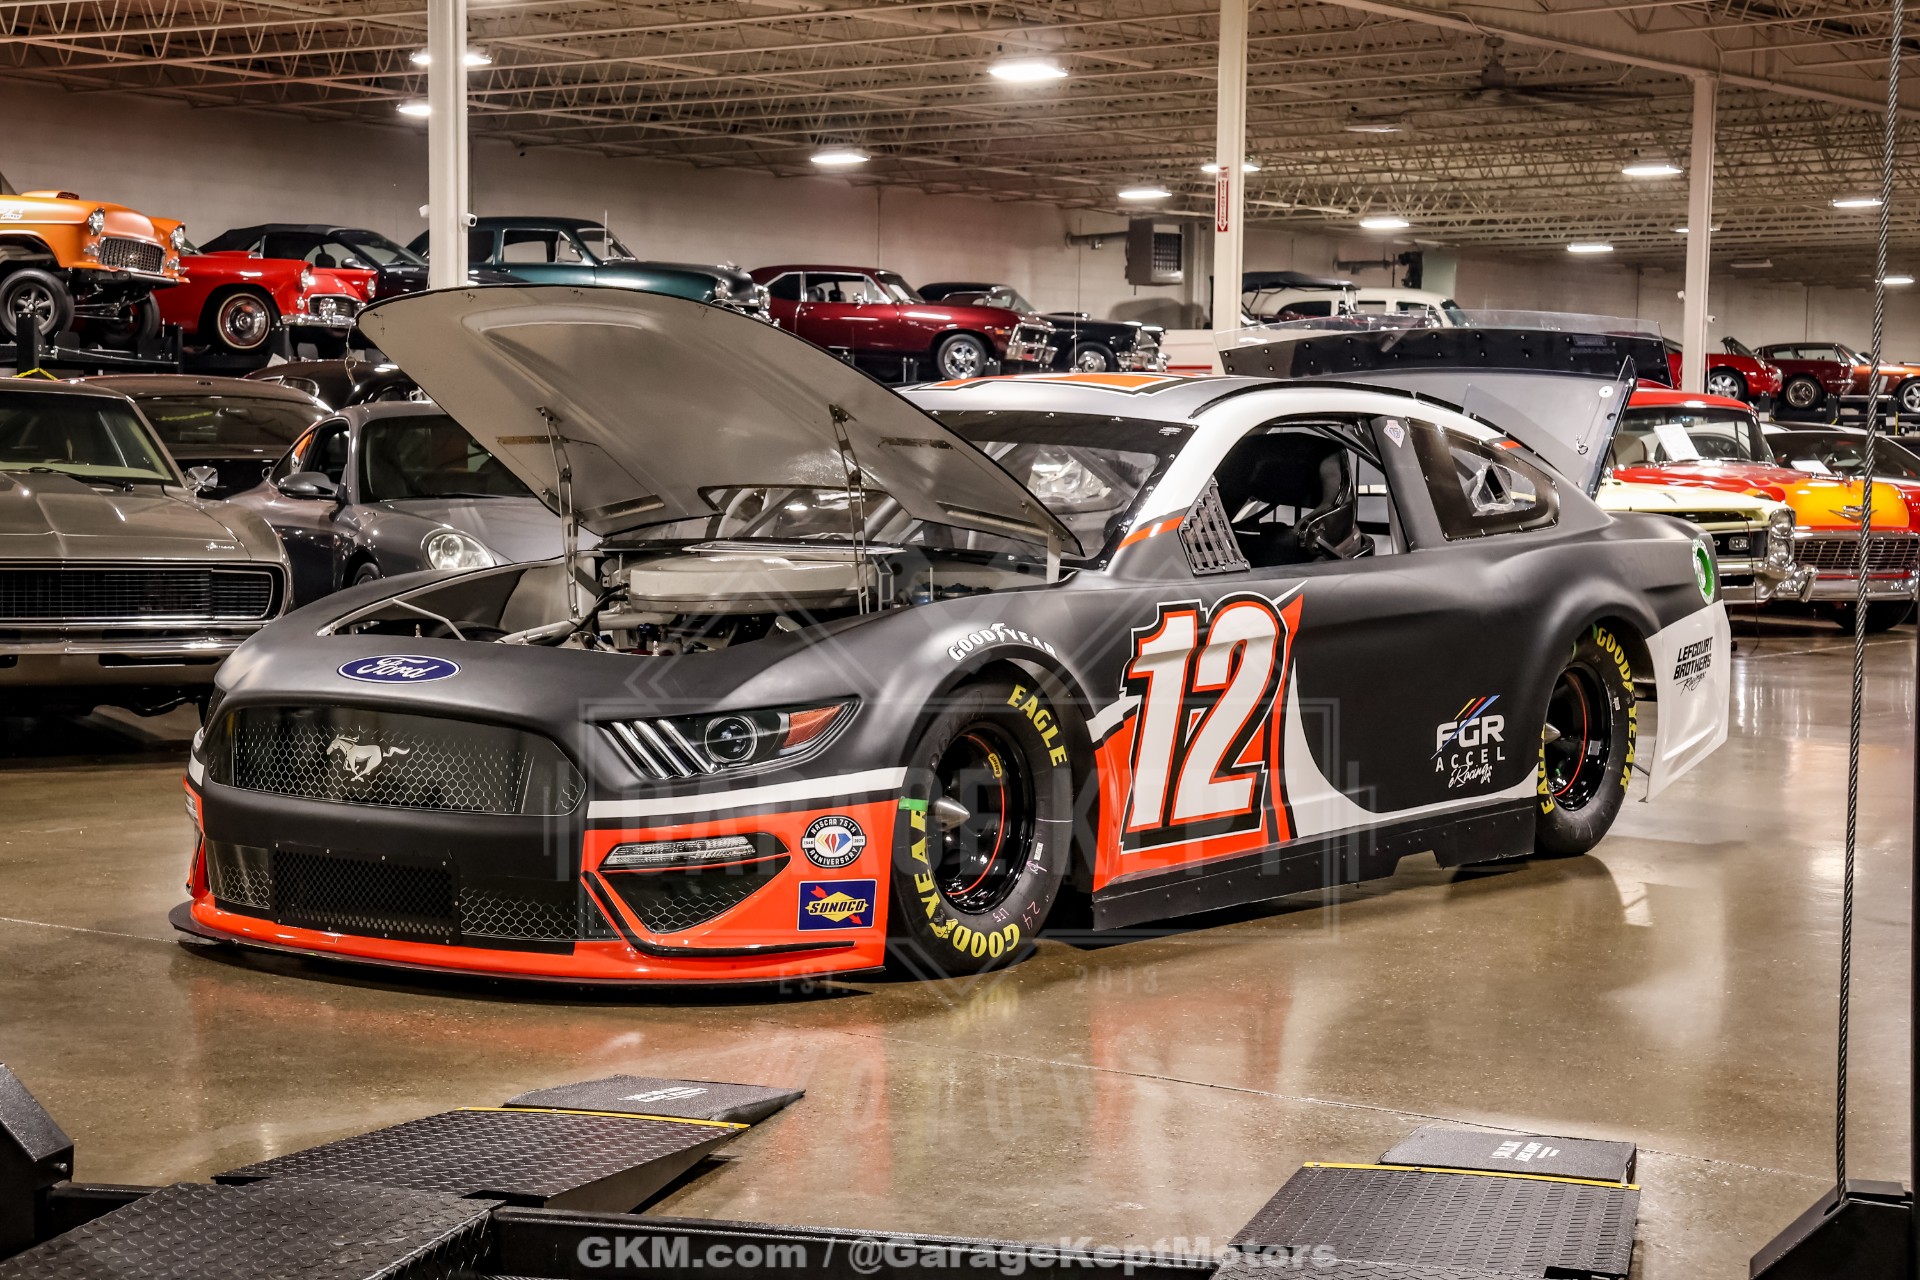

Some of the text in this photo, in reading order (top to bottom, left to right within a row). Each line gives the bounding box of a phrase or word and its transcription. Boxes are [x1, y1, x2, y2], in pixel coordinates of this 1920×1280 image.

[1677, 635, 1713, 663] LEFCOURT
[356, 656, 440, 679] Ford
[1673, 653, 1712, 680] BROTHERS
[1006, 683, 1069, 768] EAGLE
[1121, 591, 1288, 854] 12
[1434, 714, 1506, 753] FGR
[1435, 746, 1506, 773] ACCEL
[810, 818, 858, 835] NASCAR 75TH
[809, 846, 859, 866] ANNIVERSARY
[909, 806, 1021, 959] GOODYEAR
[809, 899, 866, 914] SUNOCO
